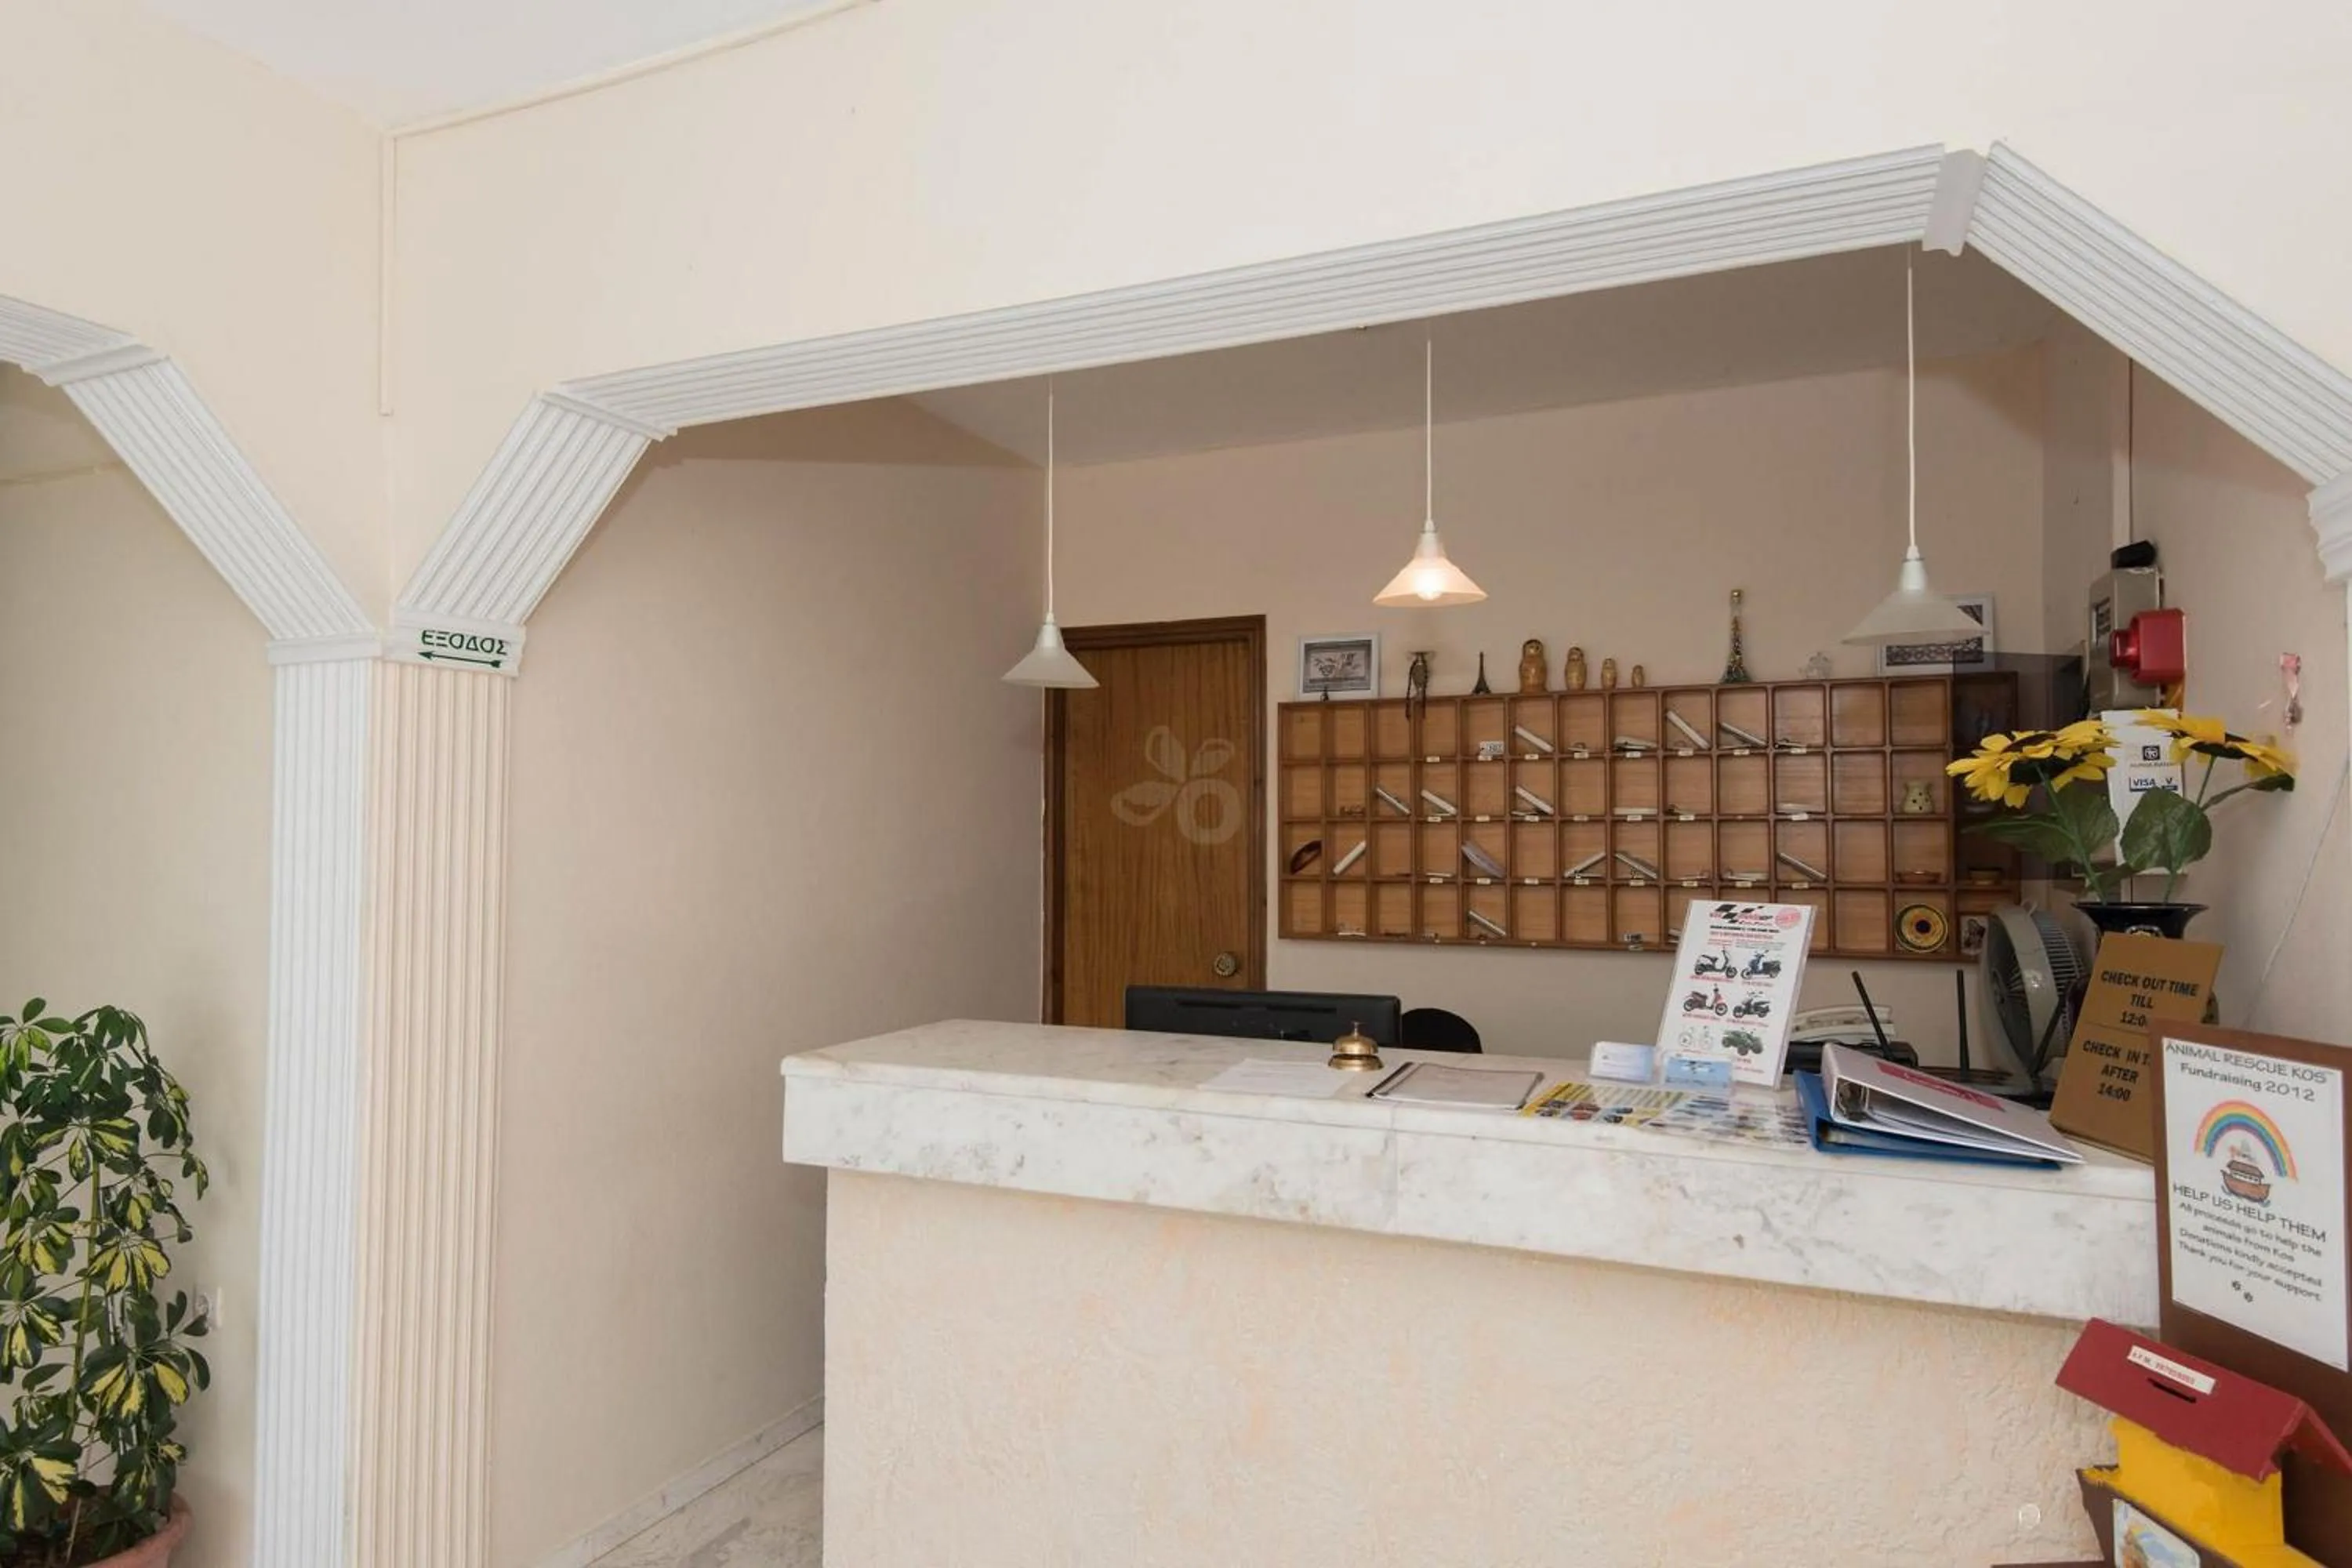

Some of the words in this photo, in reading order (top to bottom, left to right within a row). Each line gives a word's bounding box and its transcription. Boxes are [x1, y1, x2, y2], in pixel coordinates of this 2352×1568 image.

[422, 630, 512, 655] ΕΞΟΔΟΣ
[2132, 778, 2156, 786] VISA
[2101, 971, 2139, 989] CHECK
[2142, 977, 2166, 992] OUT
[2169, 980, 2199, 996] TIME
[2130, 993, 2154, 1009] TILL
[2120, 1011, 2147, 1027] 12:0
[2082, 1040, 2122, 1059] CHECK
[2126, 1049, 2142, 1065] IN
[2165, 1043, 2221, 1062] ANIMAL
[2223, 1052, 2288, 1076] RESCUE
[2292, 1065, 2328, 1084] KOS
[2101, 1063, 2140, 1084] AFTER
[2180, 1062, 2262, 1092] Fundraising
[2265, 1080, 2316, 1102] 2012
[2173, 1183, 2209, 1203] HELP
[2212, 1196, 2234, 1211] US
[2236, 1203, 2276, 1224] HELP
[2279, 1217, 2326, 1243] THEM
[2179, 1240, 2206, 1257] Thank
[2202, 1225, 2241, 1243] animals
[2244, 1236, 2271, 1252] from
[2259, 1229, 2273, 1240] to
[2275, 1233, 2299, 1251] help
[2301, 1243, 2322, 1258] the
